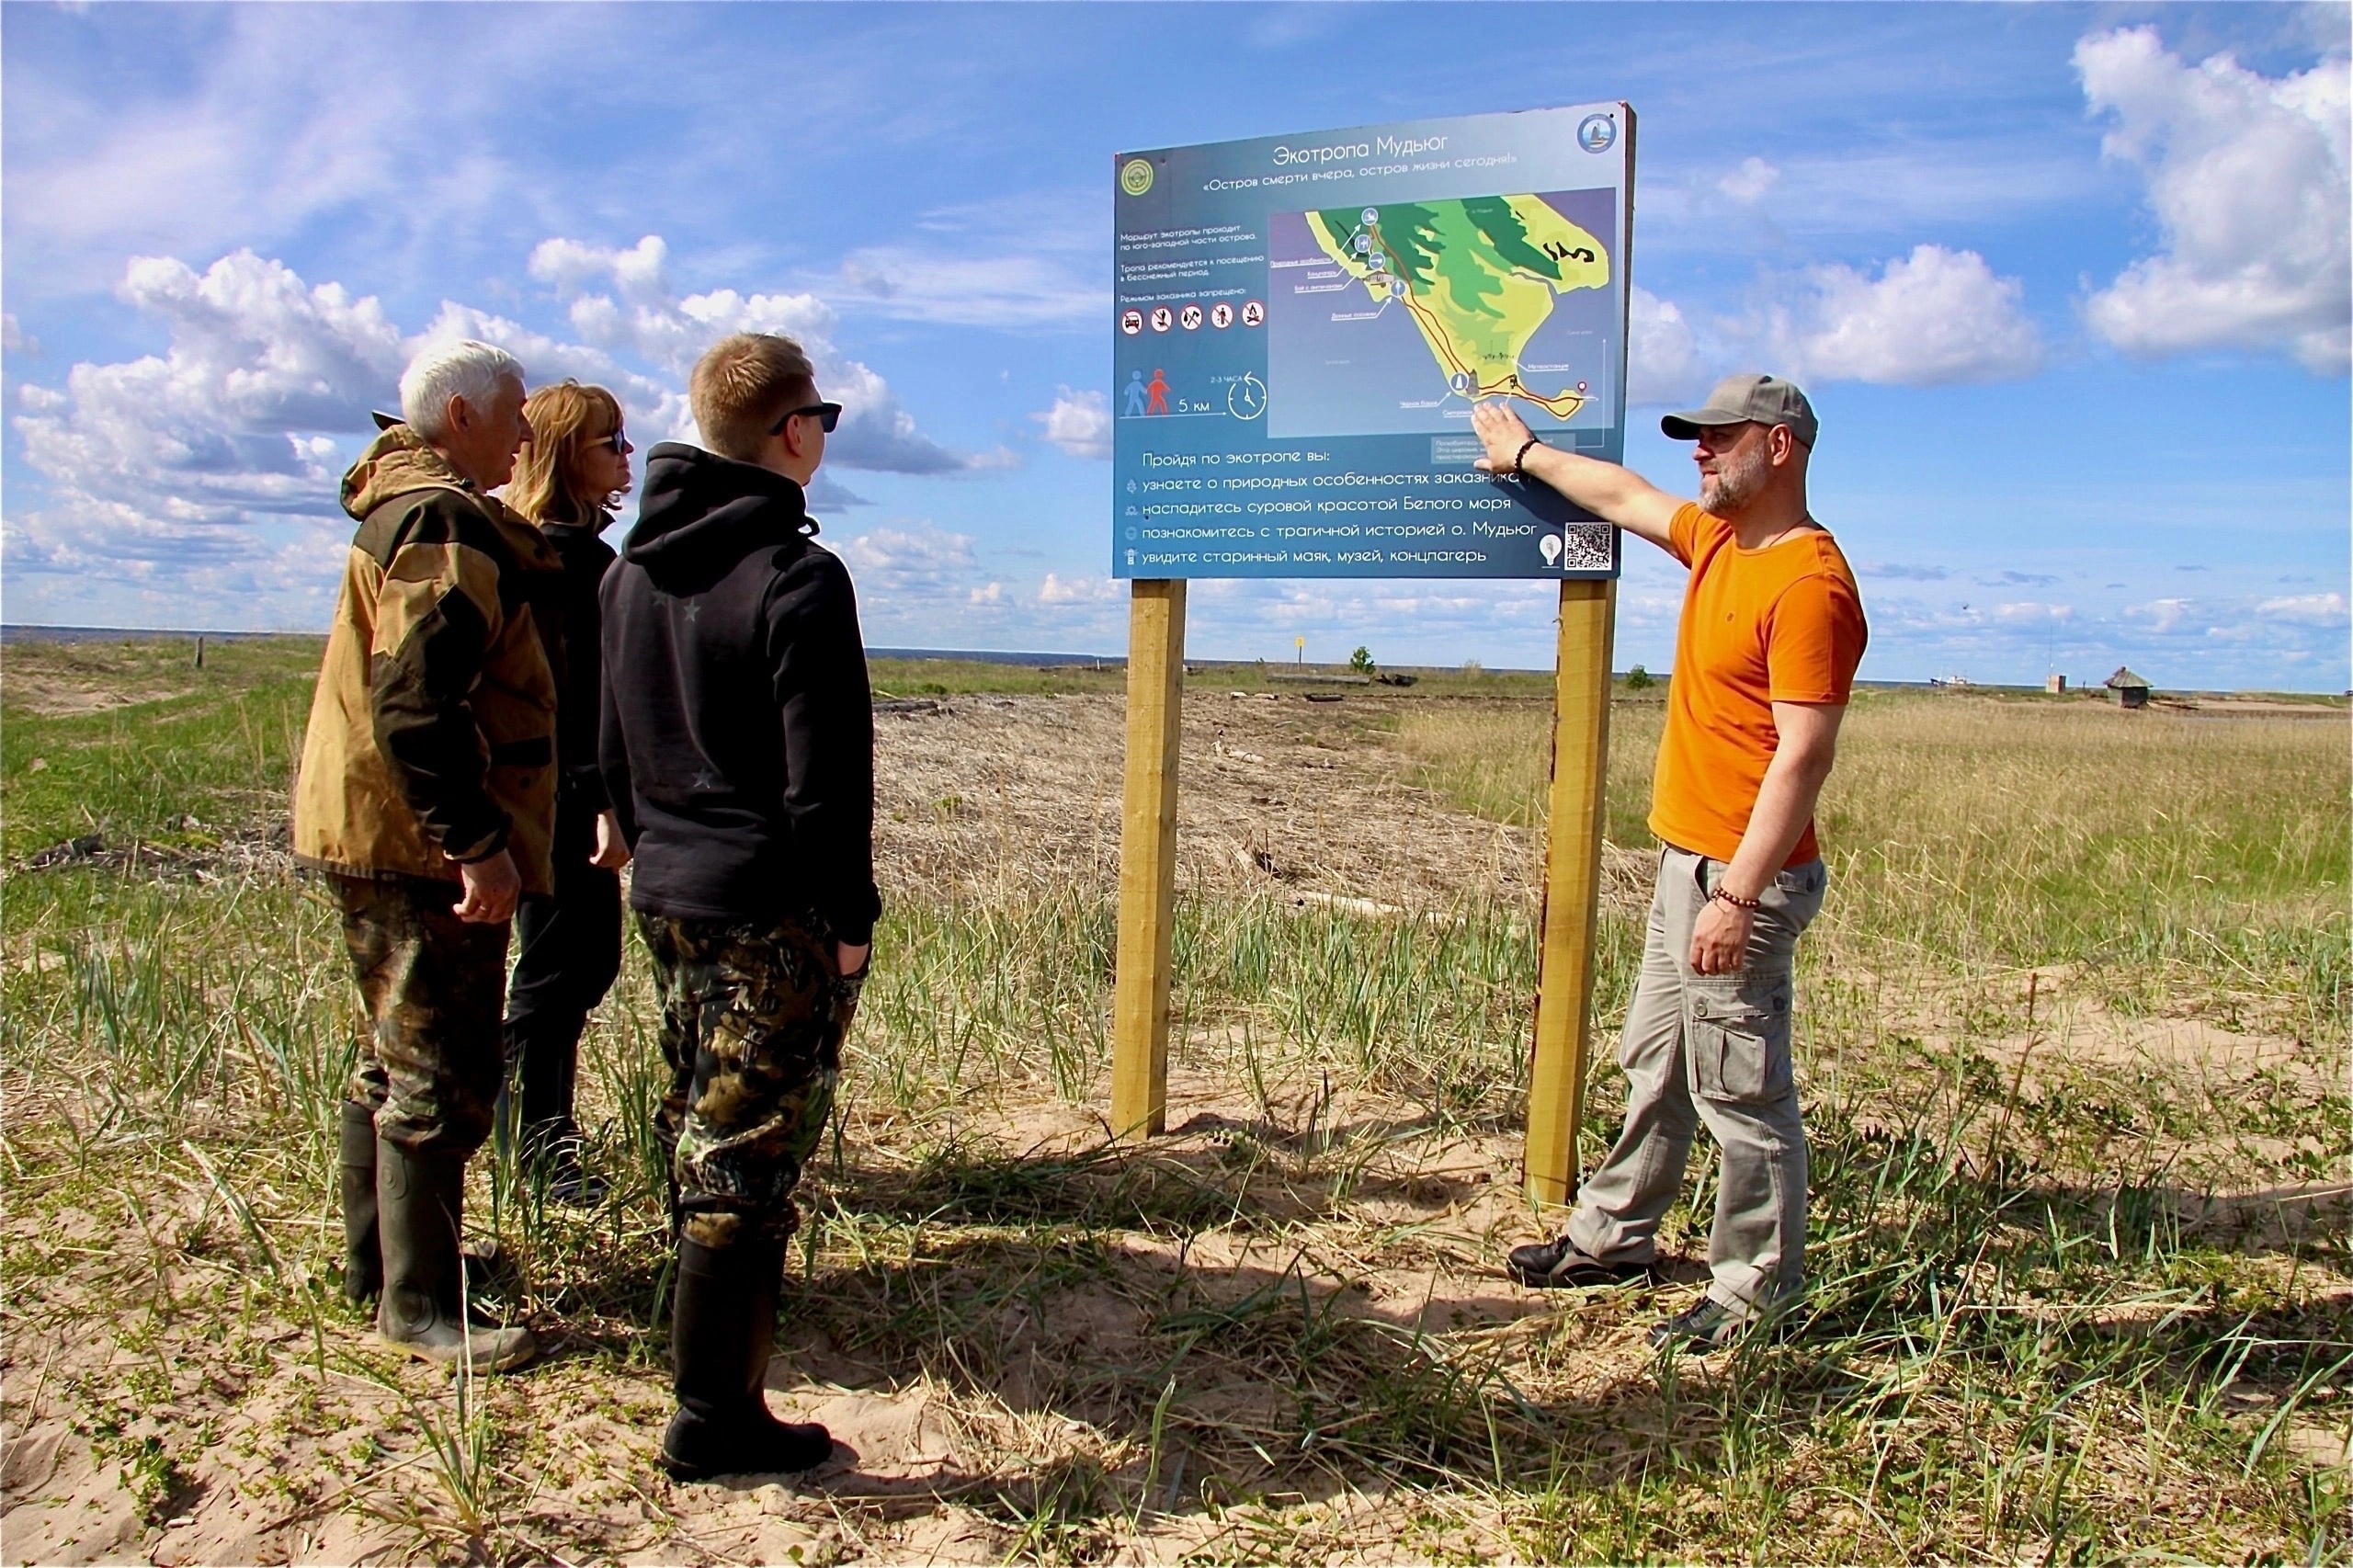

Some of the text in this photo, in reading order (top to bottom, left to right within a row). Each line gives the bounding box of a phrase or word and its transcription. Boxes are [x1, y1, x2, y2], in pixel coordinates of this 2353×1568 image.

[1272, 135, 1449, 165] Экотропа Мудьюг
[1203, 153, 1517, 191] «Остров смерти вчера, остров жизни сегодня!»
[1120, 225, 1241, 242] Маршрут экотропы проходит
[1132, 239, 1189, 249] юго-западной
[1219, 233, 1256, 244] острова.
[1120, 265, 1145, 274] Тропа
[1147, 260, 1208, 271] рекомендуется
[1216, 256, 1264, 265] посещению
[1127, 270, 1176, 281] бесснежный
[1120, 288, 1245, 302] Режимом заказника запрещено:
[1178, 399, 1188, 413] 5
[1142, 451, 1330, 469] Пройдя по экотропе вы:
[1142, 472, 1519, 493] узнаете о природных особенностях заказника
[1142, 495, 1511, 516] насладитесь суровой красотой Белого моря
[1142, 520, 1538, 540] познакомитесь с трагичной историей о. Мудьюг
[1142, 550, 1487, 565] увидите старинный маяк, музей, концлагерь
